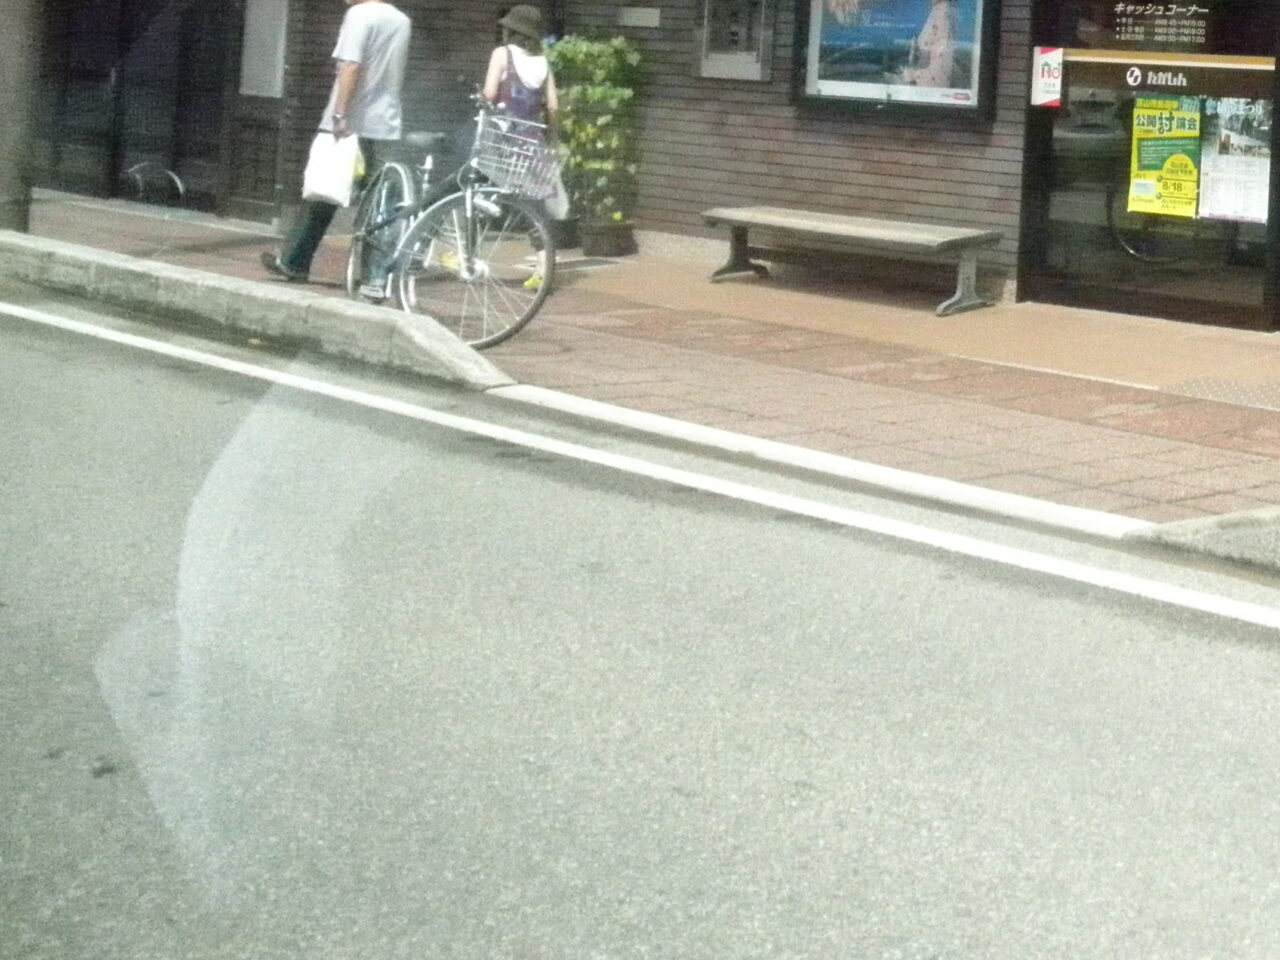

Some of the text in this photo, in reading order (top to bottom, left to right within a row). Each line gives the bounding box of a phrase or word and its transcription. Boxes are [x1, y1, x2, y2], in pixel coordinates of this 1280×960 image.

[1113, 1, 1209, 16] キャッシュコーナー
